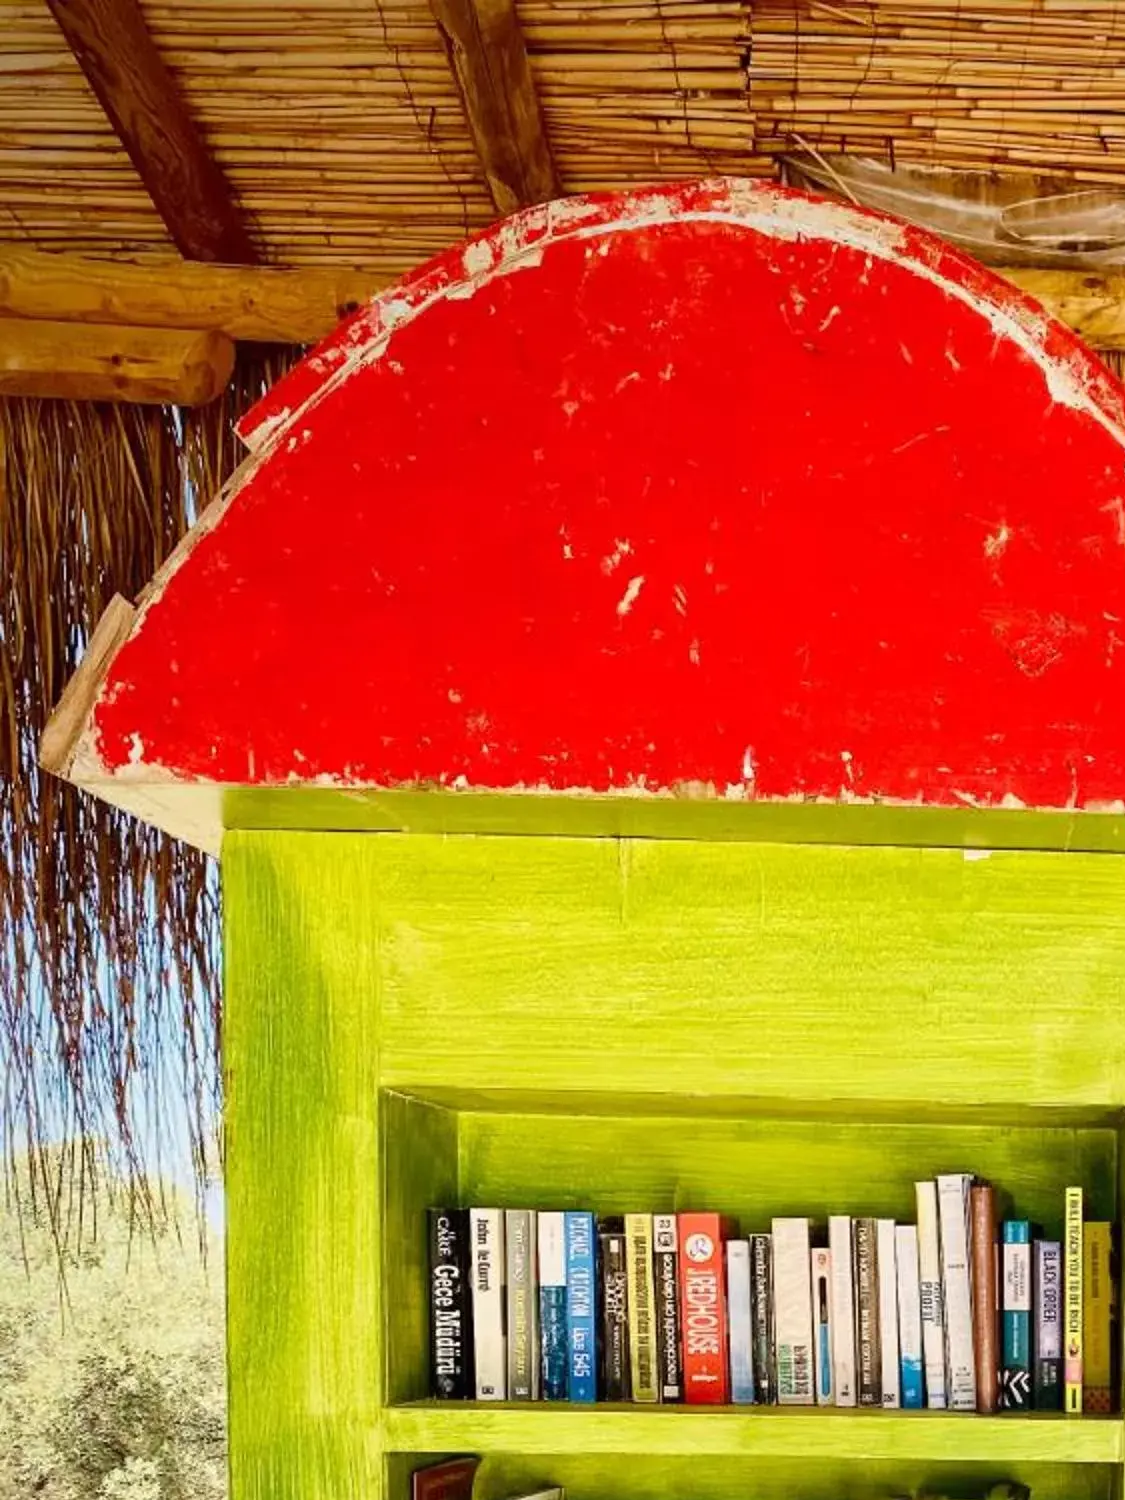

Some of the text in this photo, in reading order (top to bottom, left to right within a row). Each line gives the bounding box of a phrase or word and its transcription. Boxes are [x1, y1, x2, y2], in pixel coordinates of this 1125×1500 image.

[477, 1218, 490, 1245] John
[1043, 1250, 1058, 1324] BLACK ORDER
[1068, 1257, 1081, 1277] YOU
[434, 1264, 462, 1376] Gece Müdürü
